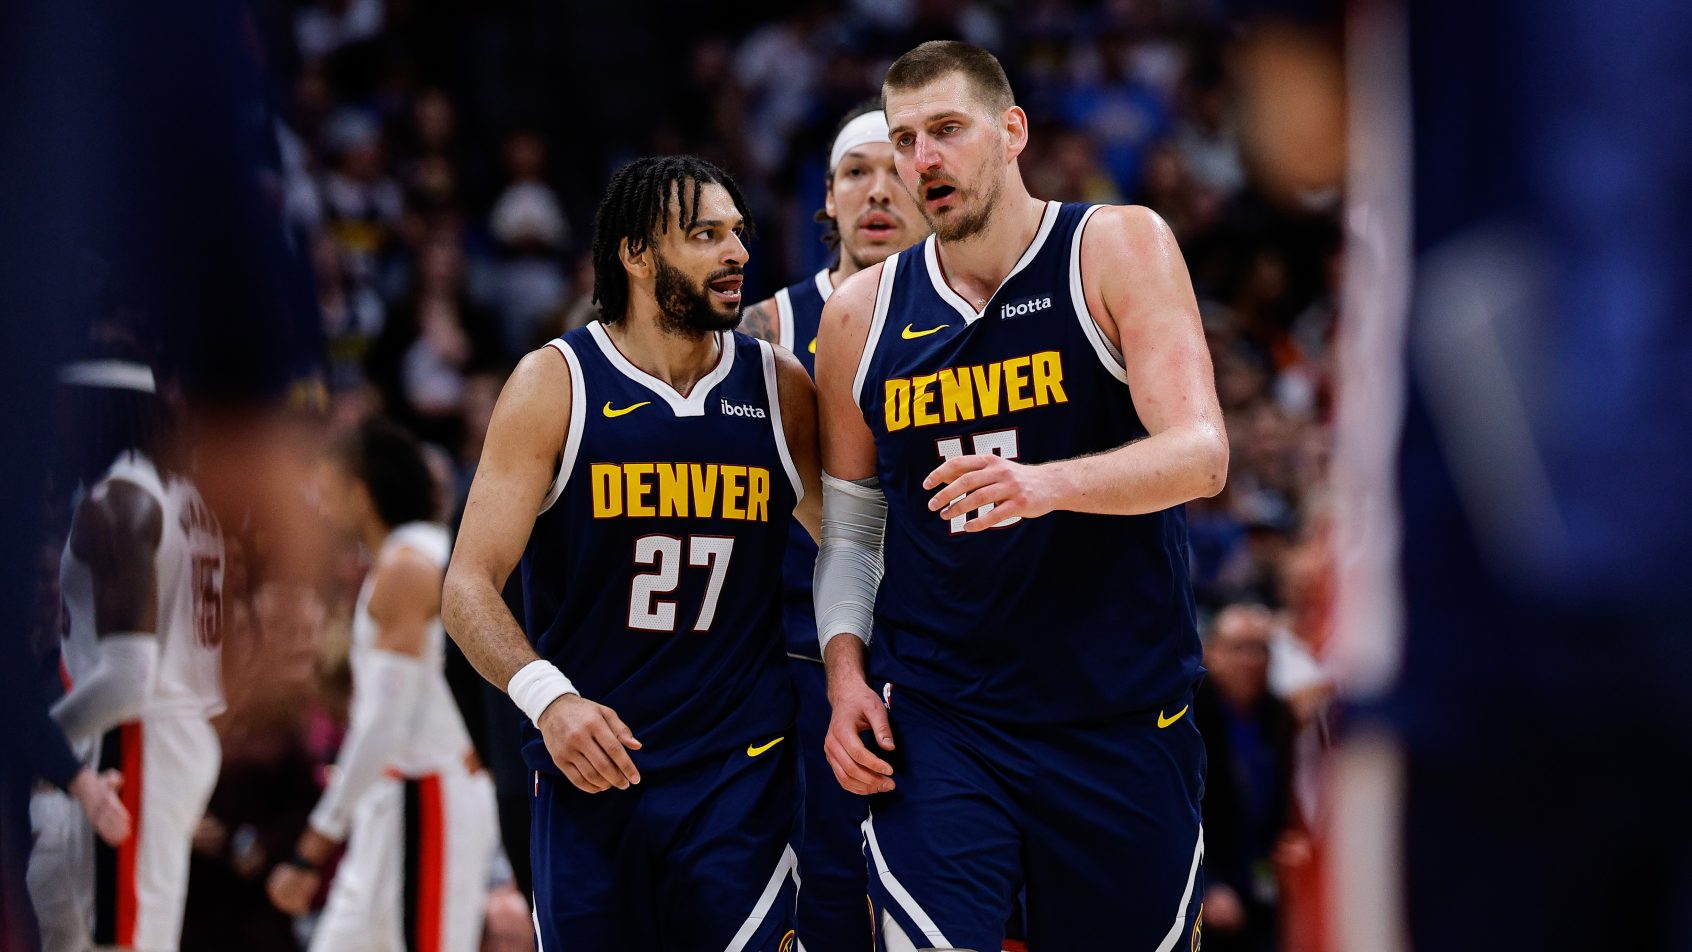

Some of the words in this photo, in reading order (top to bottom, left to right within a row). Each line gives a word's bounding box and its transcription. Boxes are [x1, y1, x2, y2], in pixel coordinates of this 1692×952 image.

[1001, 295, 1052, 319] ibotta
[720, 399, 766, 419] ibotta
[884, 351, 1068, 433] DENVER
[590, 462, 770, 522] DENVER
[627, 533, 736, 632] 27
